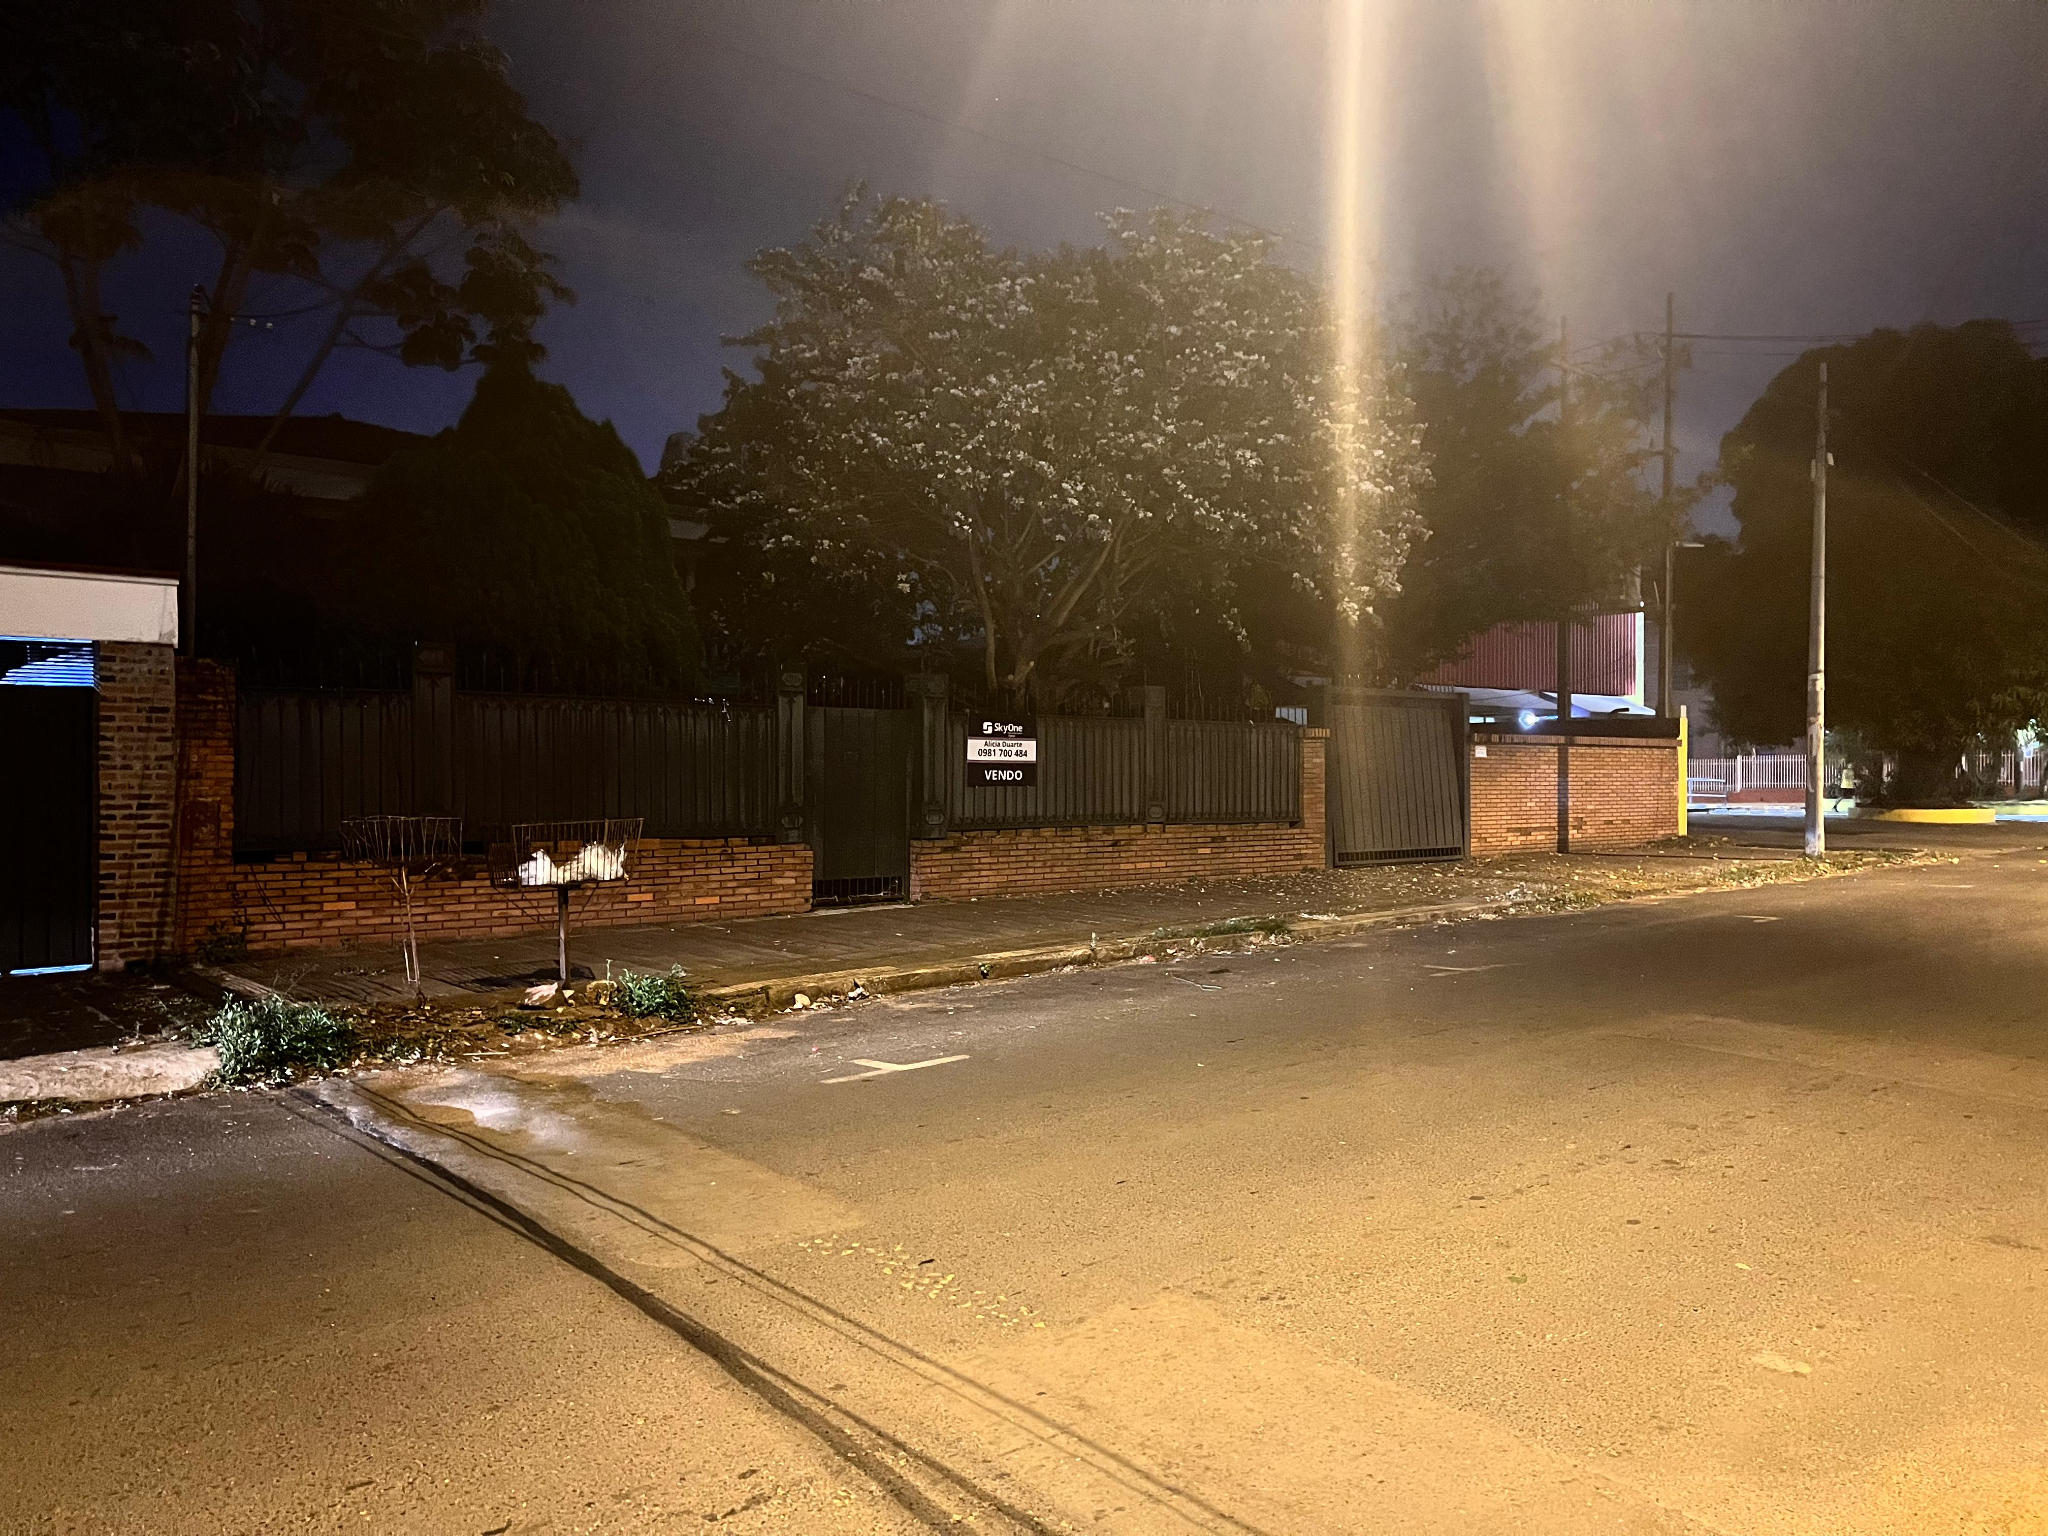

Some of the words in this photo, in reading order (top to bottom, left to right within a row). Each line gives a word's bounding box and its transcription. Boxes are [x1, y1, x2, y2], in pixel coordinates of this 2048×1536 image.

[994, 722, 1023, 734] SkyOne
[978, 748, 996, 757] 0981
[998, 749, 1013, 757] 700
[1014, 749, 1028, 758] 484
[984, 769, 1023, 781] VENDO
